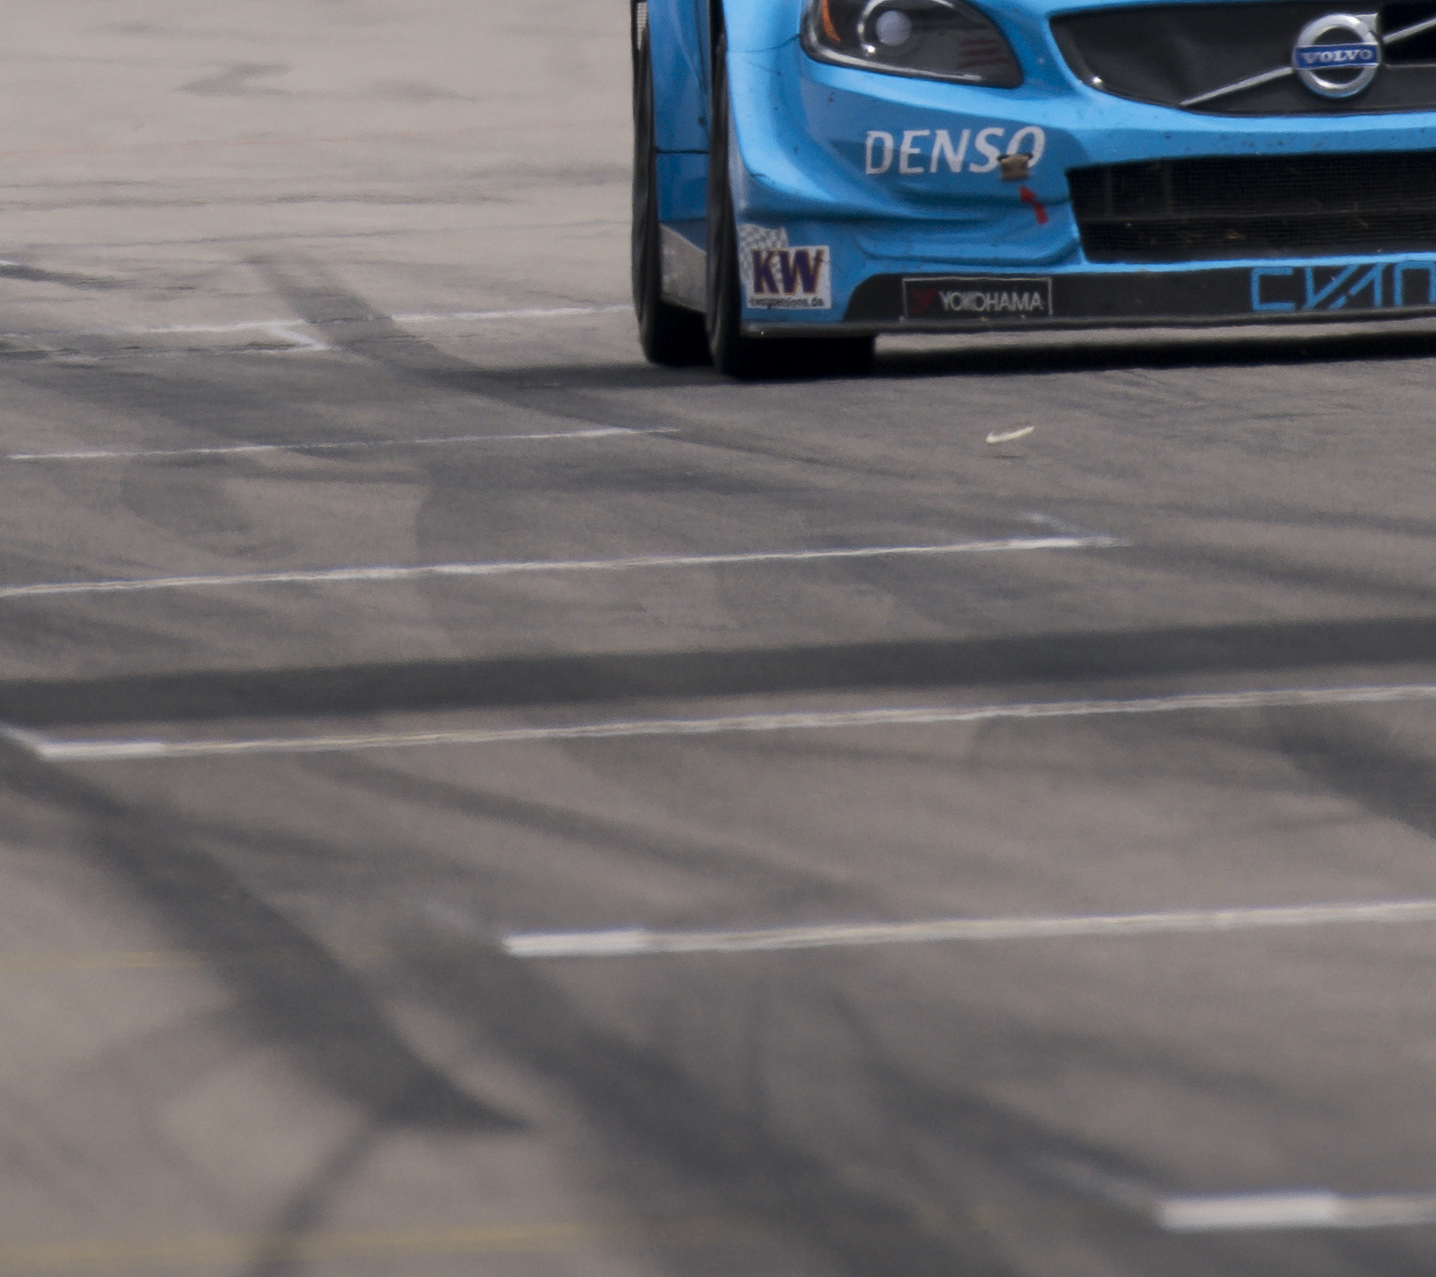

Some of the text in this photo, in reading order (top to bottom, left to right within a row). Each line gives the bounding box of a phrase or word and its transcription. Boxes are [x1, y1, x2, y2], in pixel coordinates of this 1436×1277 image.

[1303, 48, 1372, 64] VOLVO
[865, 126, 1045, 175] DENSO
[751, 248, 825, 295] KW
[938, 291, 1044, 312] YOKOHAMA
